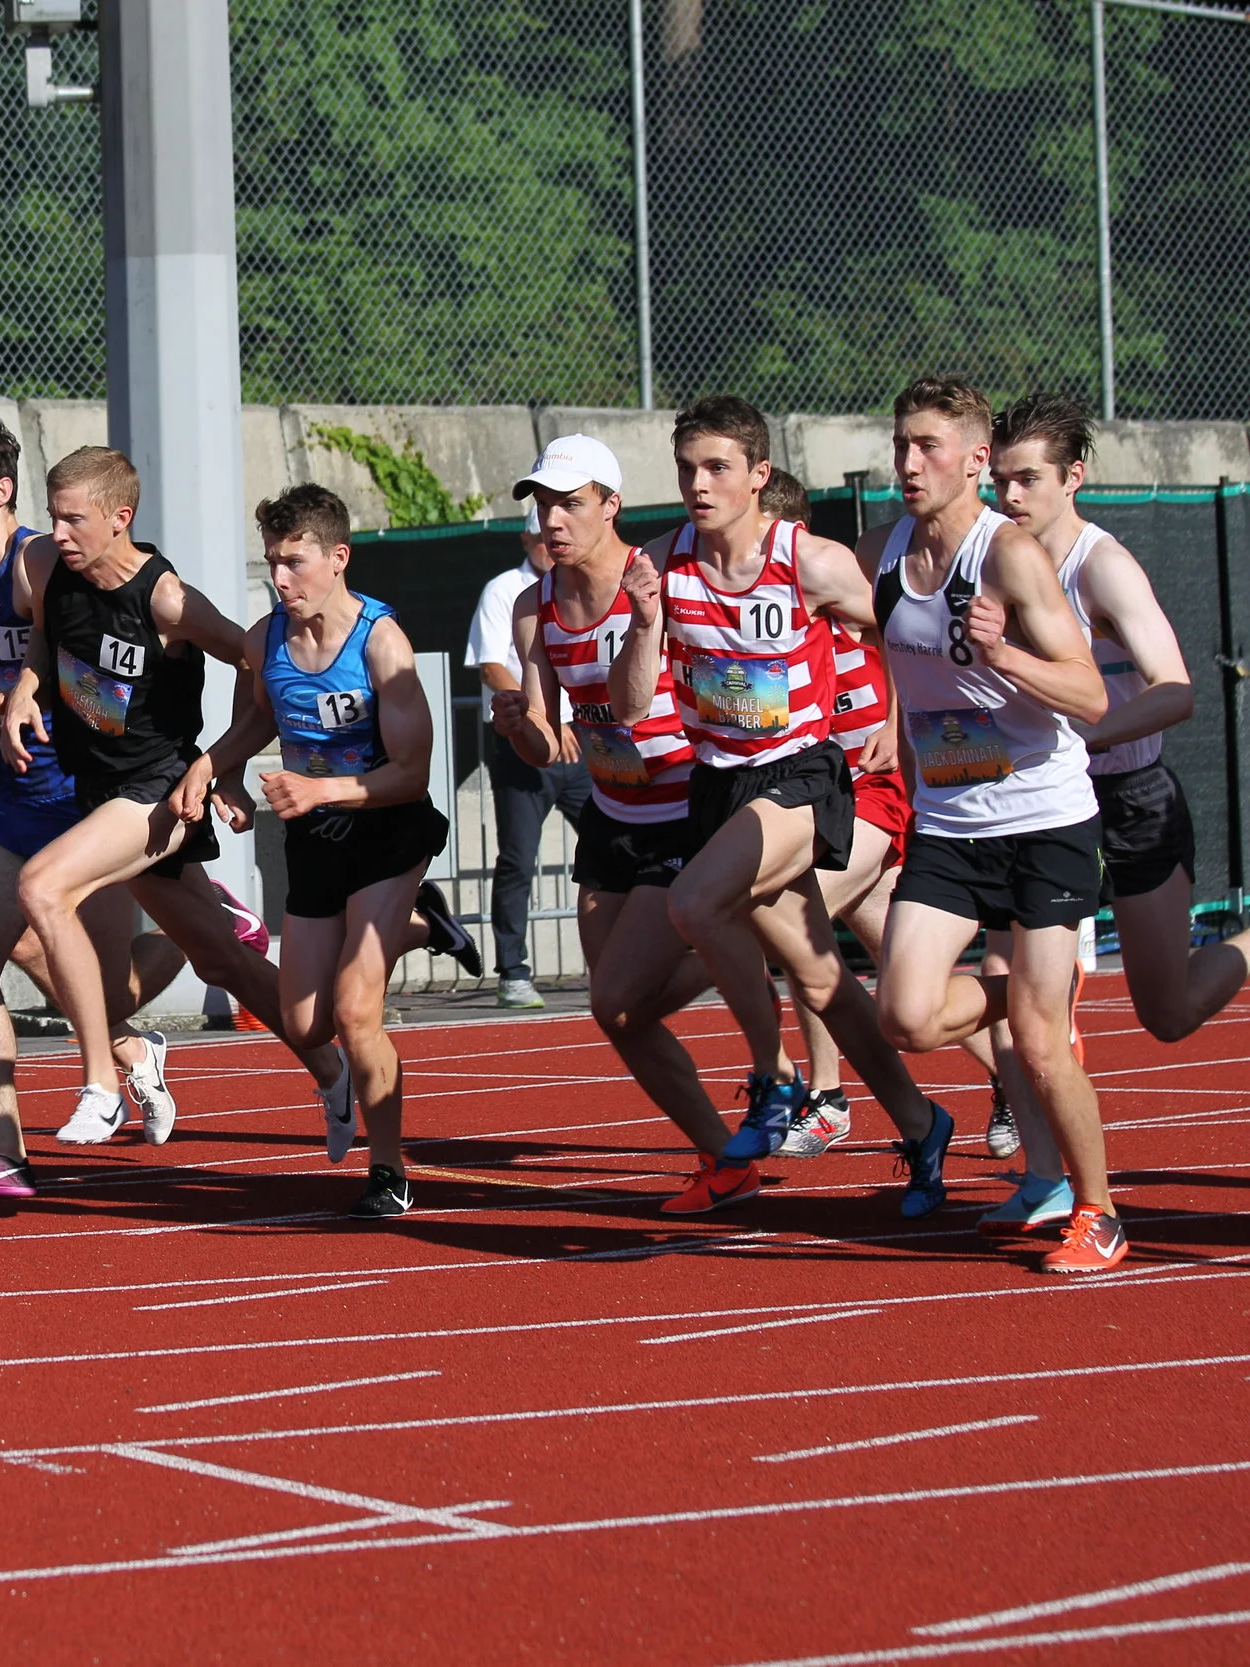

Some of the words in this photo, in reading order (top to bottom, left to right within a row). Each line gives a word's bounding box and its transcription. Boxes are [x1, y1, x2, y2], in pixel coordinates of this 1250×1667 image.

[680, 608, 706, 616] KUKRI
[749, 603, 783, 639] 10
[3, 629, 30, 660] 15
[109, 641, 136, 675] 14
[605, 630, 626, 663] 1
[917, 642, 943, 657] Harrie
[948, 618, 973, 667] 8
[326, 693, 359, 726] 13
[712, 695, 764, 713] MICHAEL
[922, 751, 948, 768] JACK
[949, 744, 1002, 766] DANNATT
